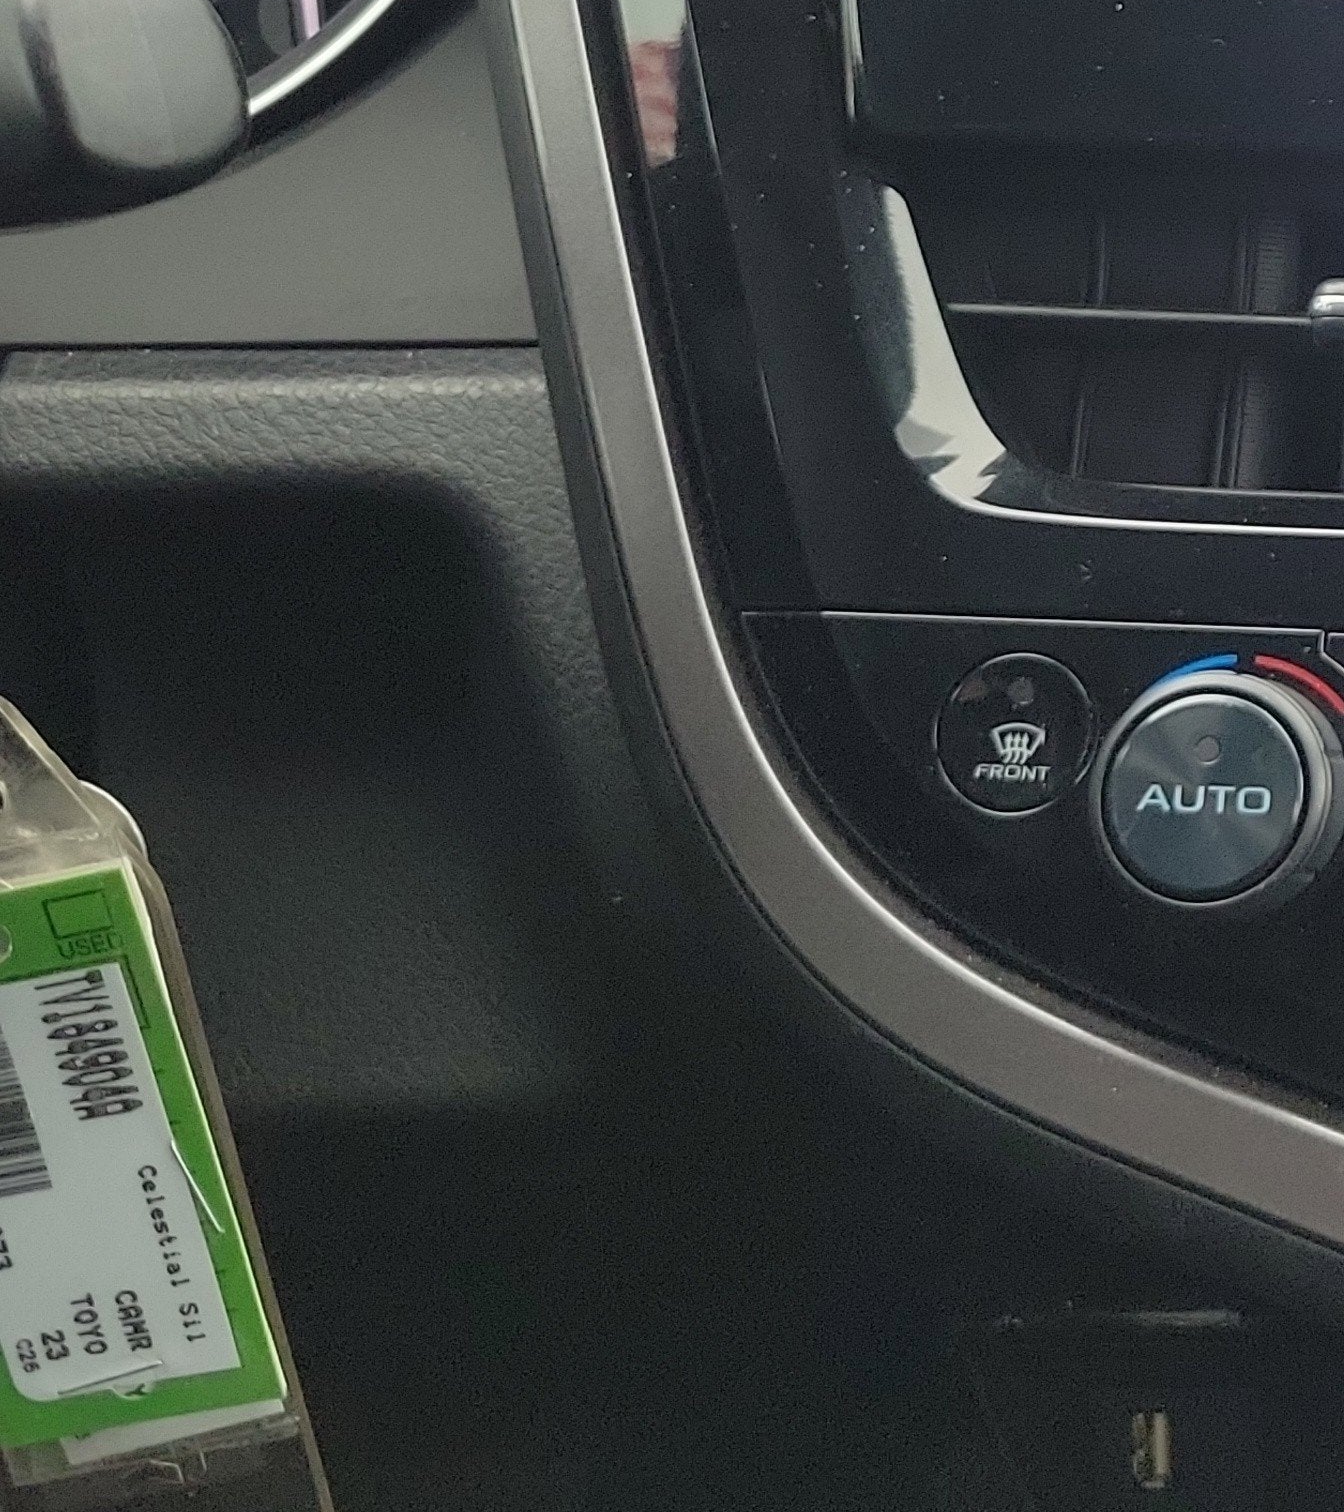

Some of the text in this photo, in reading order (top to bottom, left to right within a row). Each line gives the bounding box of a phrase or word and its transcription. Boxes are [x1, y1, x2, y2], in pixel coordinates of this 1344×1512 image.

[974, 764, 1051, 781] FRONT
[1137, 784, 1271, 814] AUTO
[34, 969, 143, 1120] TV184904A
[138, 1165, 206, 1342] Celestial Sil
[41, 1330, 70, 1360] 23
[70, 1293, 108, 1354] TOYO
[115, 1290, 152, 1351] CAMR
